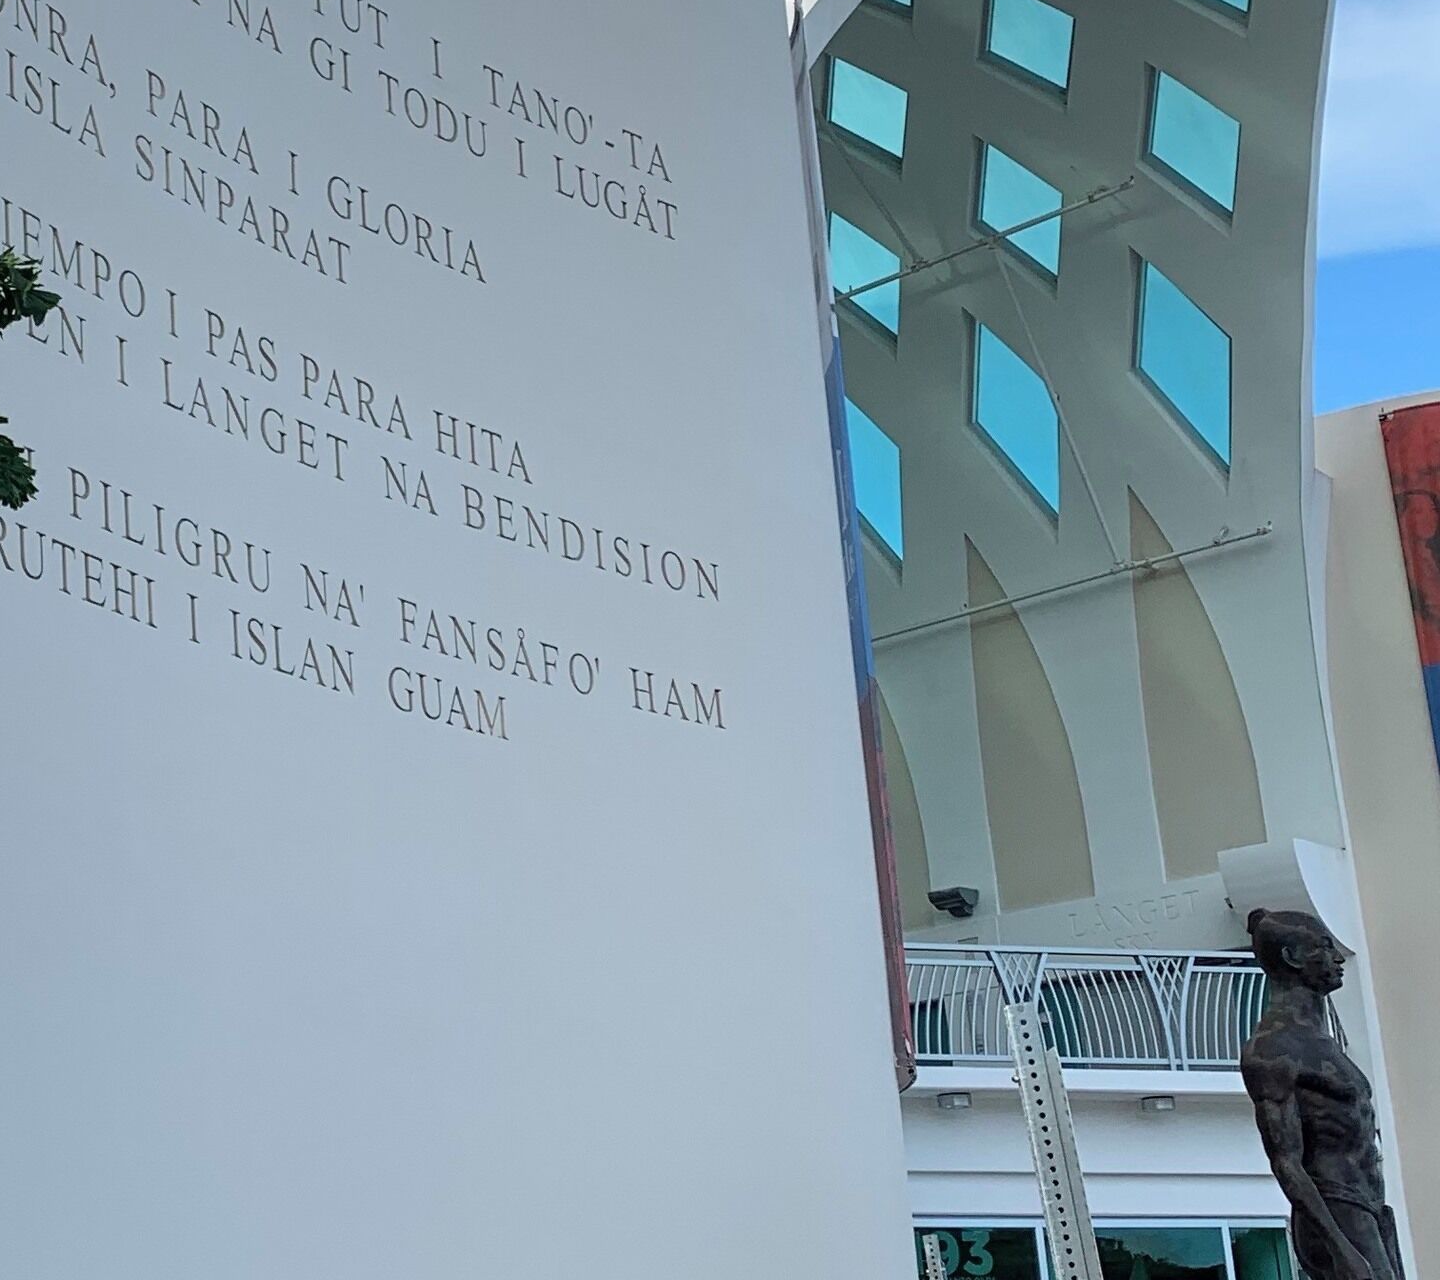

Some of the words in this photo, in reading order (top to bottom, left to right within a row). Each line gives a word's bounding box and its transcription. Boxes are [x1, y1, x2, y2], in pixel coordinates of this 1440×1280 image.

[309, 37, 353, 94] GI
[378, 69, 488, 158] TODU
[514, 137, 528, 179] I
[552, 154, 678, 241] LUGÅT
[430, 37, 442, 80] I
[5, 48, 107, 159] ISLA
[134, 133, 351, 285] SINPARAT
[146, 68, 260, 176] PARA
[288, 150, 300, 197] I
[327, 175, 488, 285] GLORIA
[115, 334, 128, 388] I
[160, 357, 349, 482] LANGET
[380, 455, 440, 517] NA
[460, 483, 720, 602] BENDISION
[166, 289, 179, 339] I
[203, 308, 279, 383] PAS
[299, 352, 414, 441] PARA
[433, 410, 534, 485] HITA
[67, 466, 272, 594] PILIGRU
[300, 563, 364, 628] NA'
[628, 666, 727, 730] HAM
[186, 593, 201, 645] I
[228, 608, 355, 697] ISLAN
[388, 666, 510, 741] GUAM
